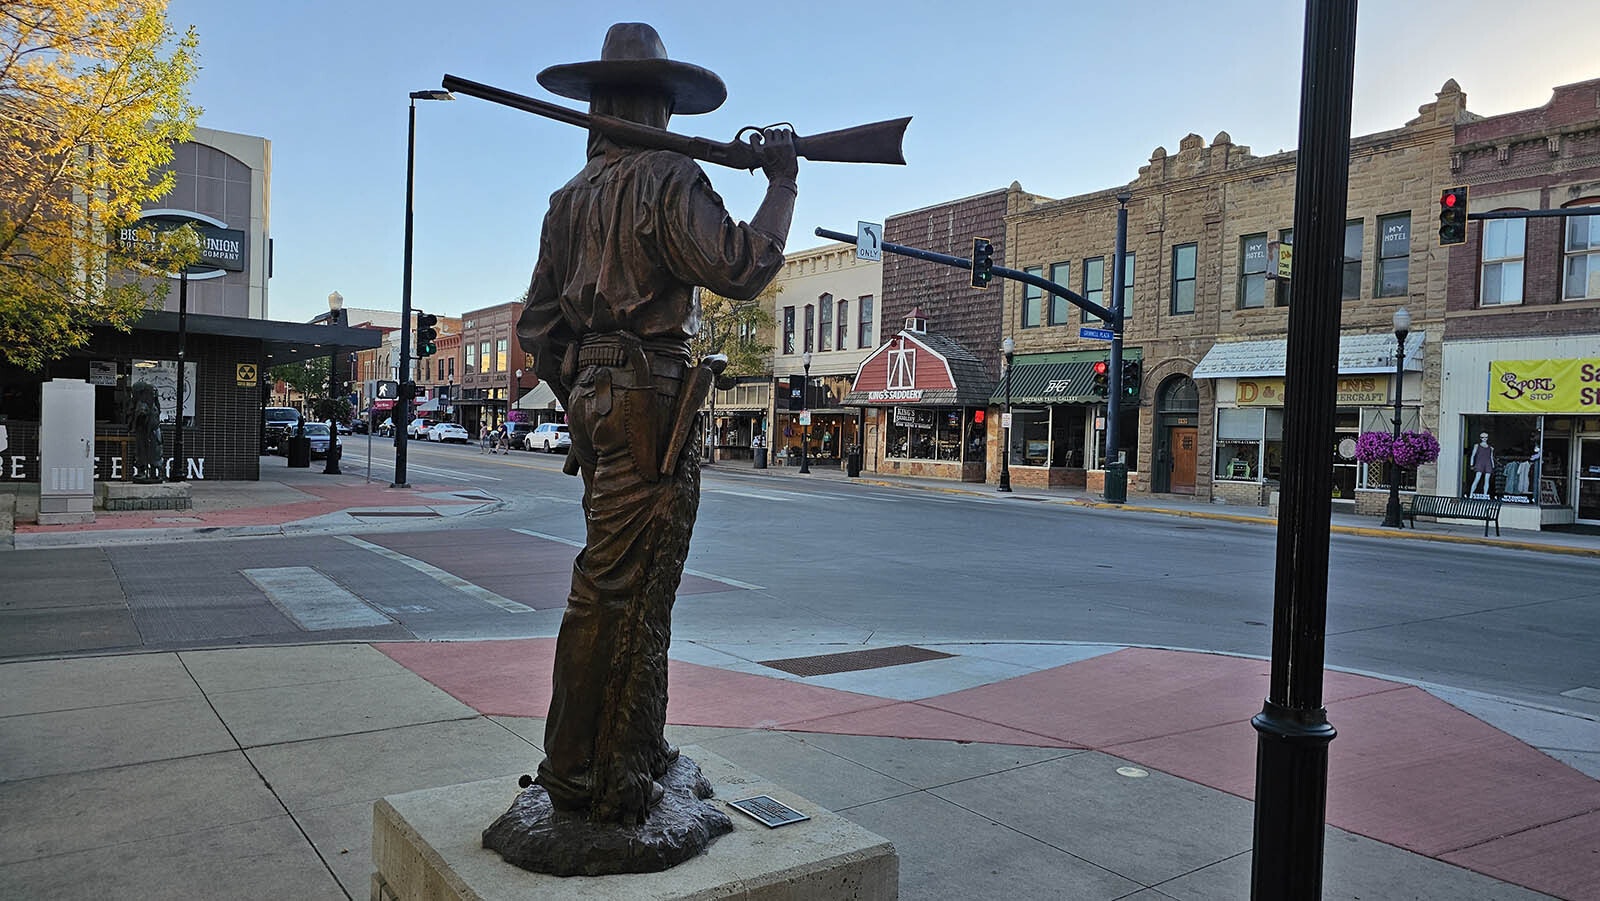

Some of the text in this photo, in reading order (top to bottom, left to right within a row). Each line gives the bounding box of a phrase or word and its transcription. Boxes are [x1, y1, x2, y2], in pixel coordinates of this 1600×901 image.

[1389, 225, 1404, 233] MY
[203, 238, 240, 253] UNION
[202, 250, 240, 260] COMPANY
[860, 248, 878, 258] ONLY
[868, 389, 923, 400] KING'S SADDLERY
[1238, 381, 1275, 403] D &
